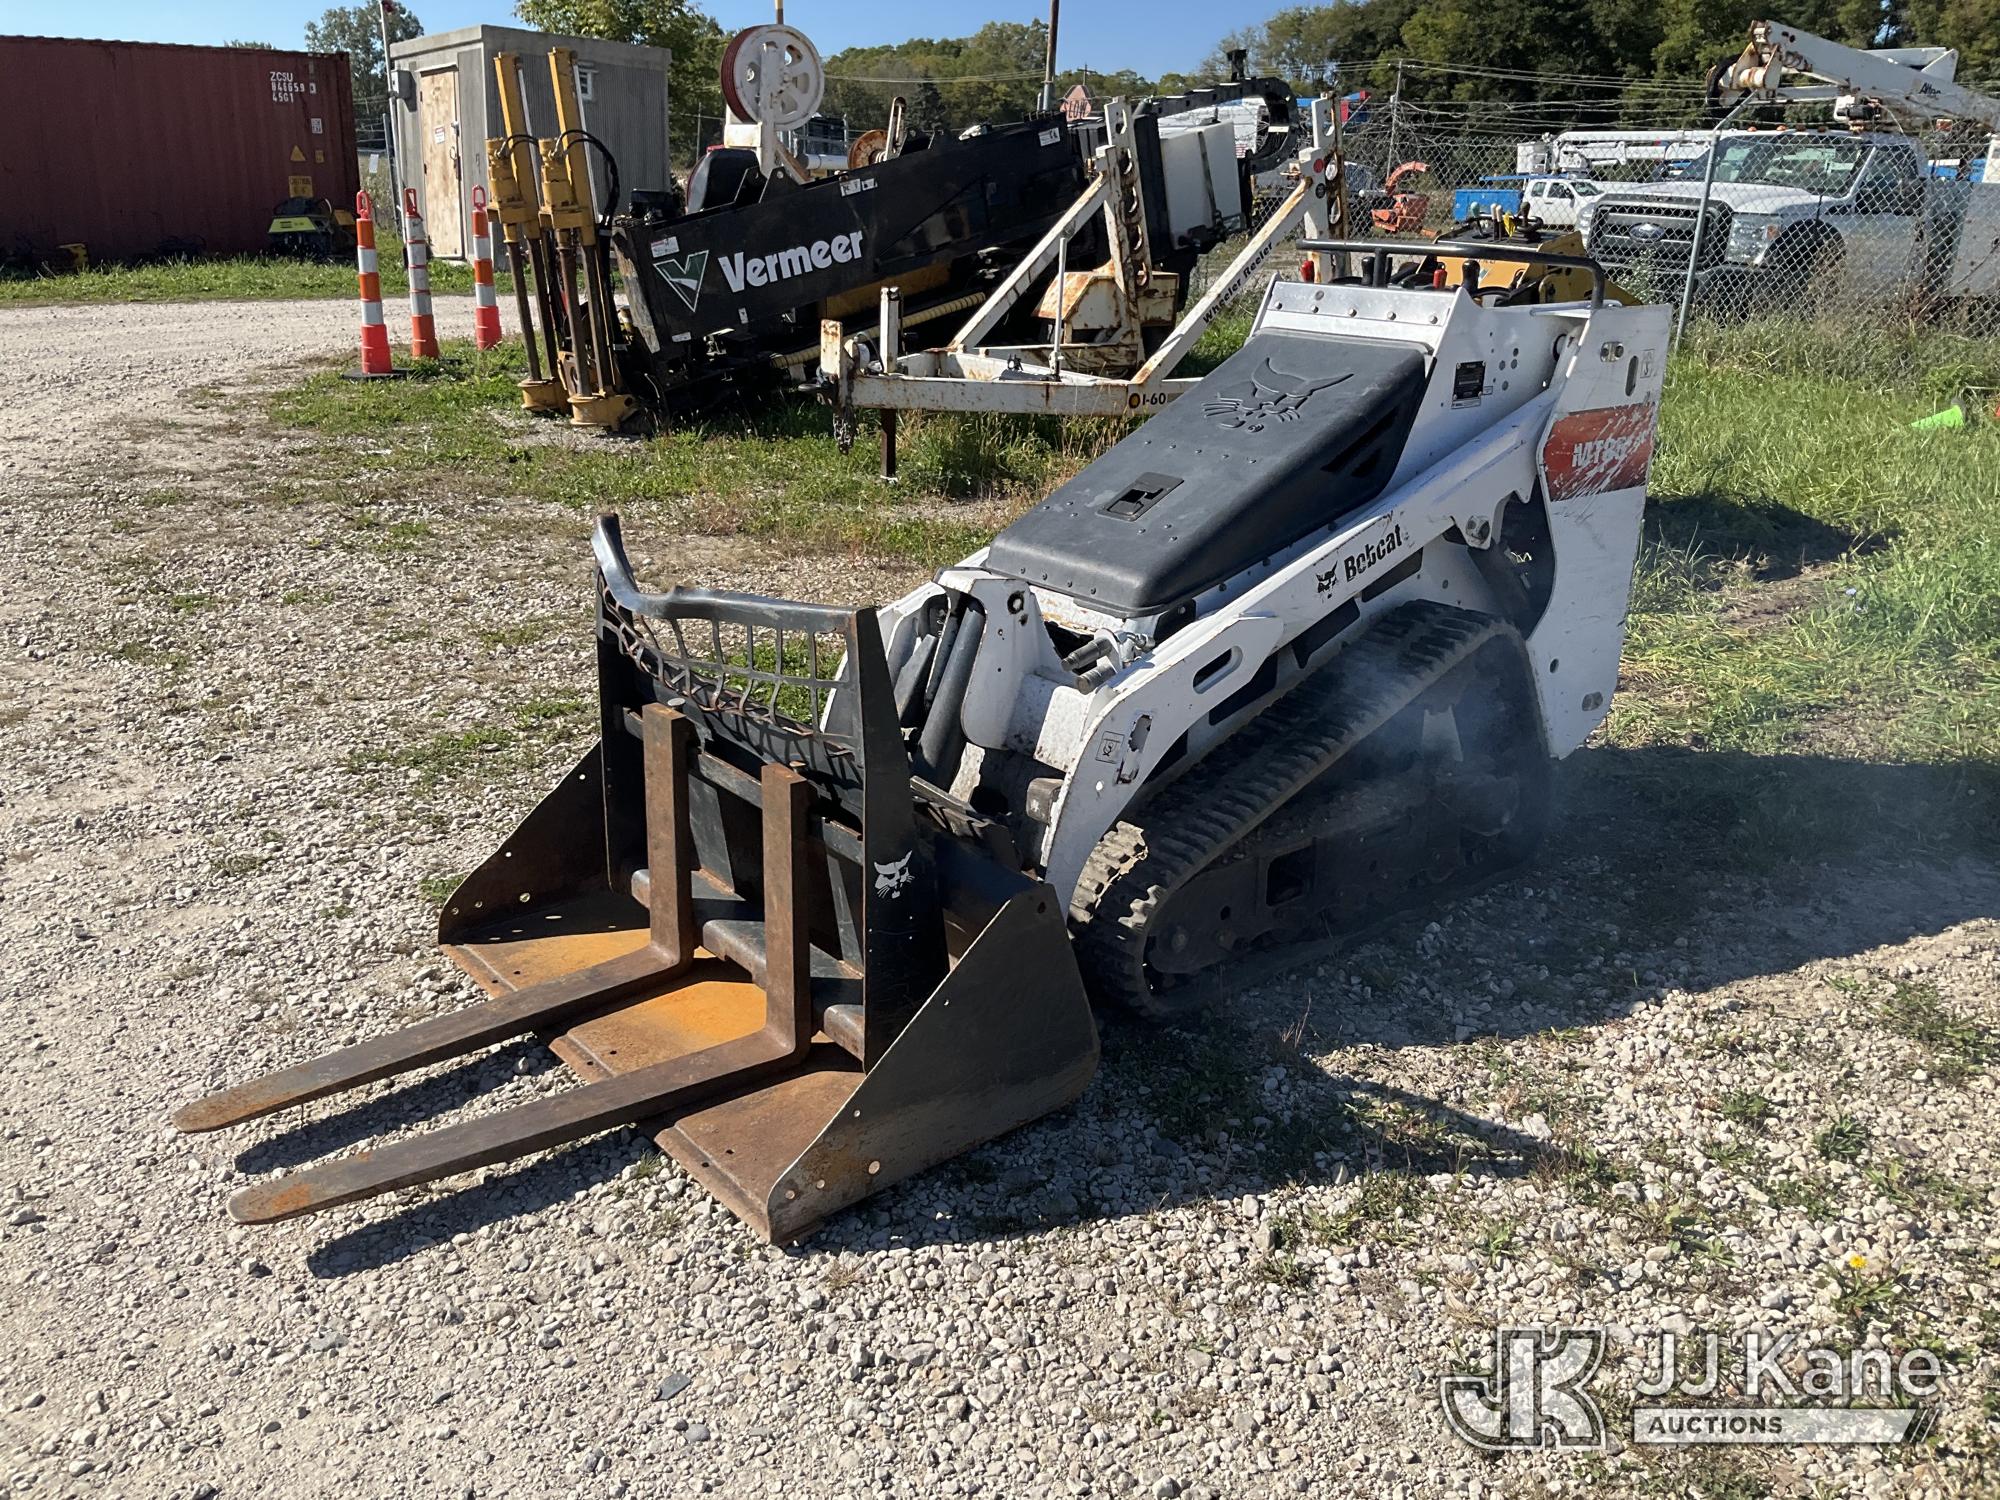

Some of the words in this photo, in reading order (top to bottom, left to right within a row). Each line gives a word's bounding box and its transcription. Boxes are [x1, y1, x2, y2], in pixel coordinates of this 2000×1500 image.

[270, 71, 294, 82] ZCSU
[272, 92, 294, 104] 45G1
[717, 230, 863, 293] Vermeer
[1202, 278, 1242, 324] Wheeler
[1242, 241, 1273, 279] Reeler
[1344, 523, 1403, 583] Bobcat
